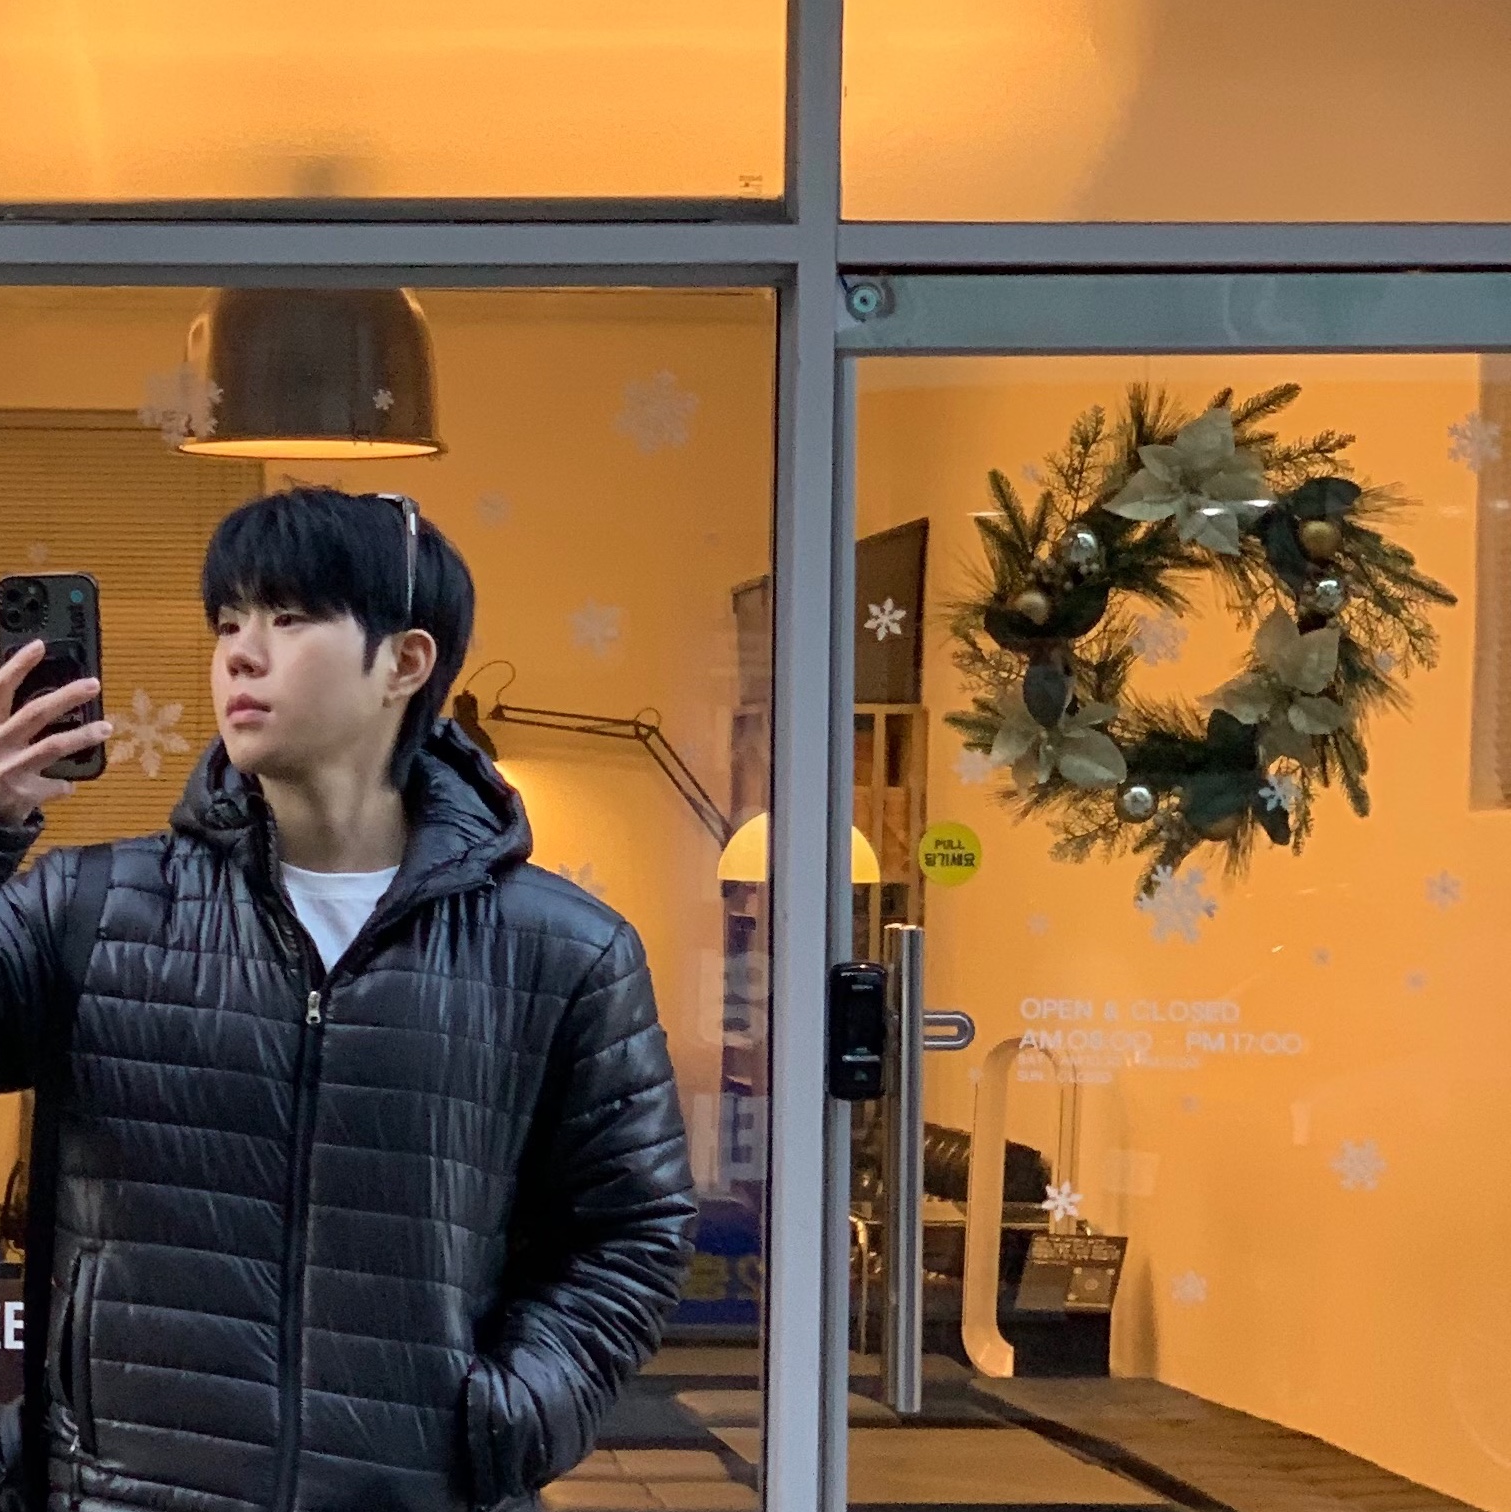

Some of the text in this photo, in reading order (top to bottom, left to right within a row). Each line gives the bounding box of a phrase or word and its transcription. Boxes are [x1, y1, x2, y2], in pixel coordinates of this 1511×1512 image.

[934, 839, 965, 850] PULL
[1020, 998, 1240, 1022] OPEN & CLOSED
